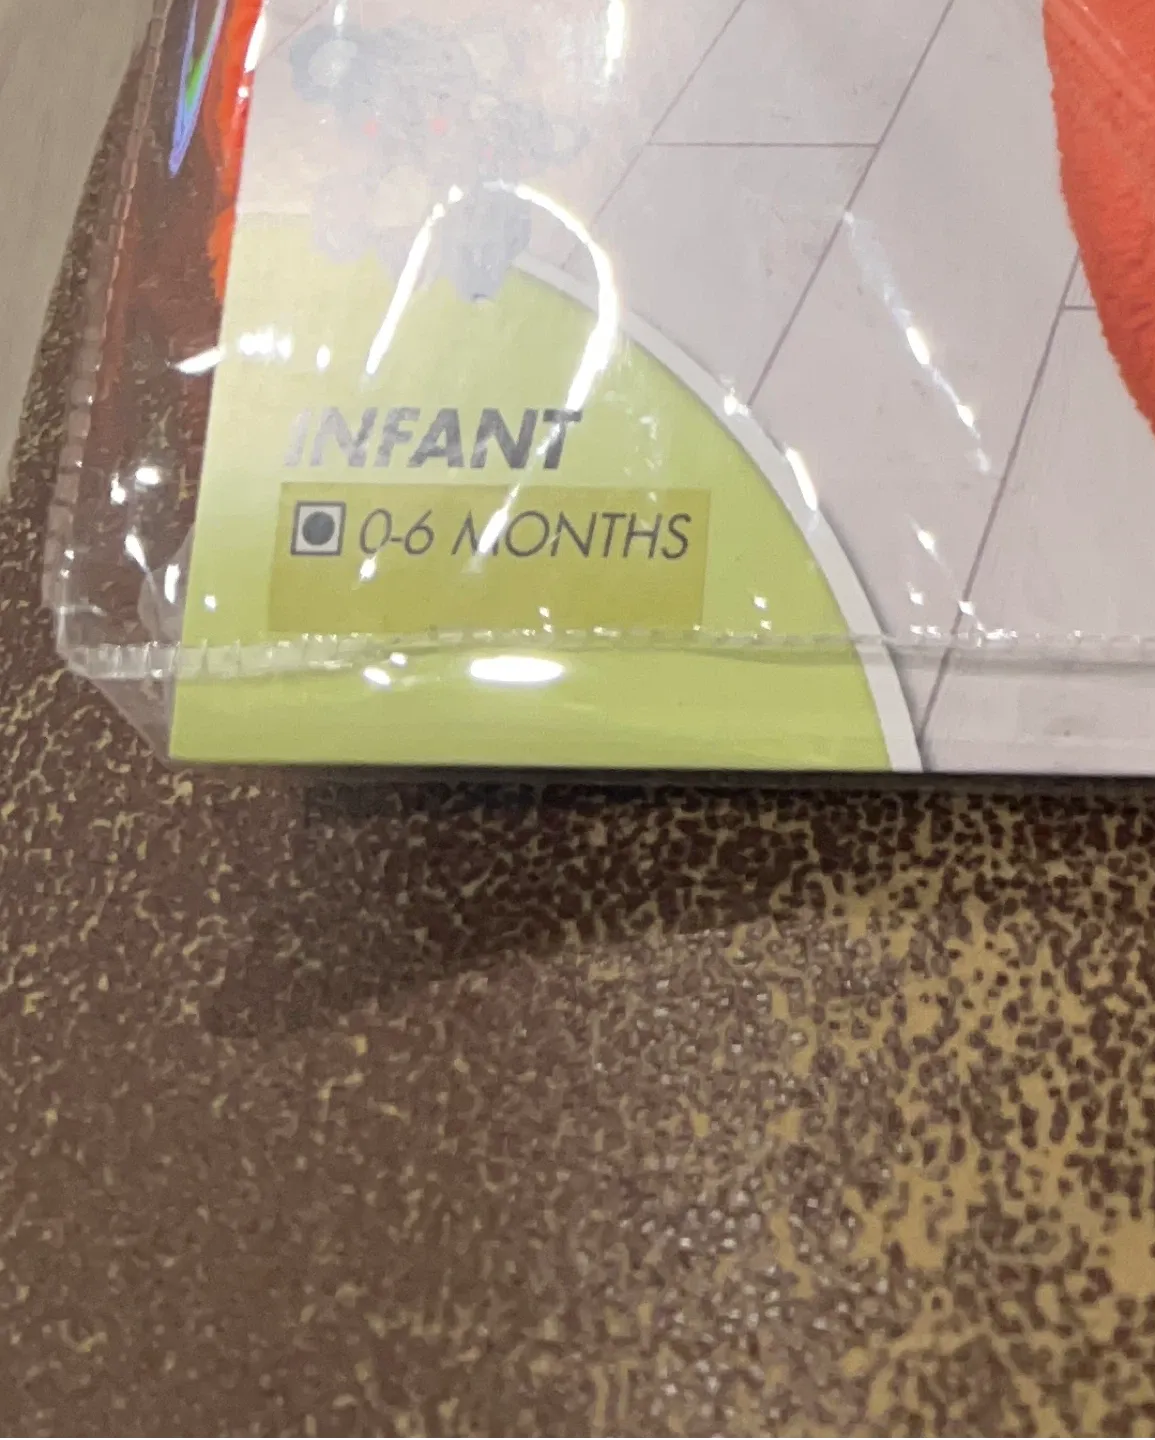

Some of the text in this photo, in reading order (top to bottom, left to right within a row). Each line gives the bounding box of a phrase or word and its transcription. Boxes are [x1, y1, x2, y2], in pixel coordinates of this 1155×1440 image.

[284, 406, 583, 470] INFANT
[359, 507, 692, 560] 0-6 MONTHS
